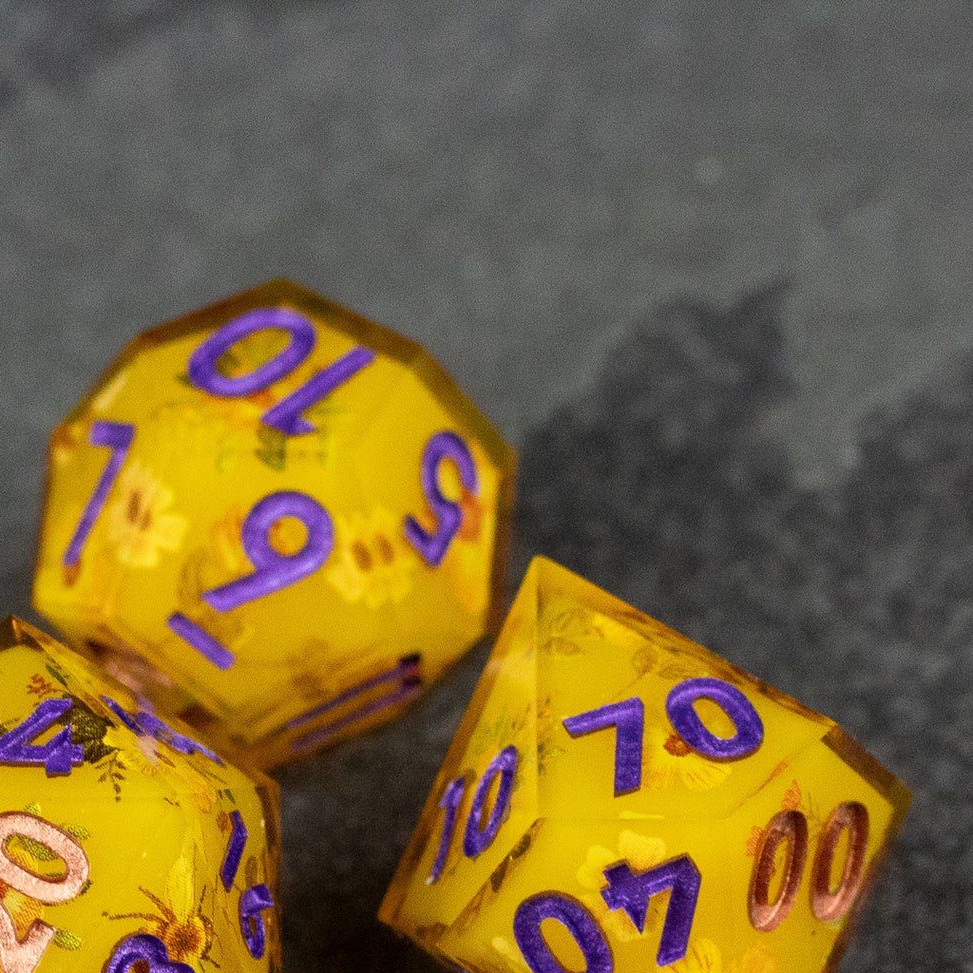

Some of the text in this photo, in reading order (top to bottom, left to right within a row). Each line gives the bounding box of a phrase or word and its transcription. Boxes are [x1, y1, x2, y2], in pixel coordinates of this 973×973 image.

[187, 307, 375, 436] 10
[405, 431, 478, 566] 5
[169, 491, 334, 670] 9
[561, 676, 764, 794] 70
[426, 744, 518, 880] 10
[748, 801, 871, 933] 00
